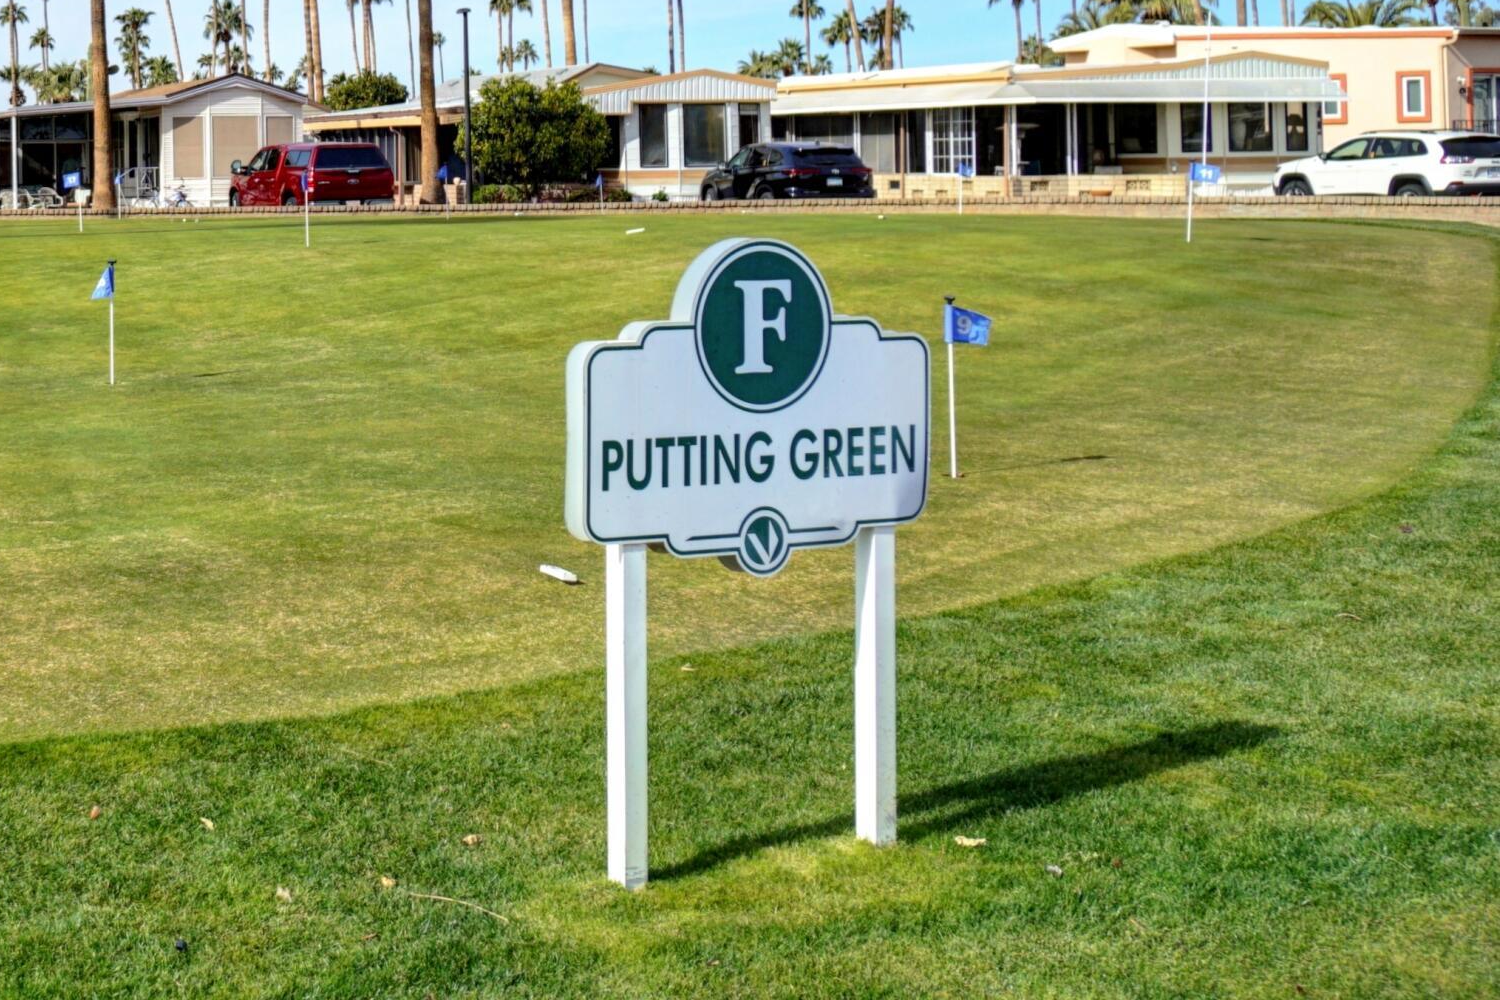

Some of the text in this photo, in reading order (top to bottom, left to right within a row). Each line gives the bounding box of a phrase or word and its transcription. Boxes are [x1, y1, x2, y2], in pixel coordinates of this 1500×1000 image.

[733, 278, 793, 375] F
[956, 315, 973, 336] 9
[601, 423, 916, 492] PUTTING GREEN
